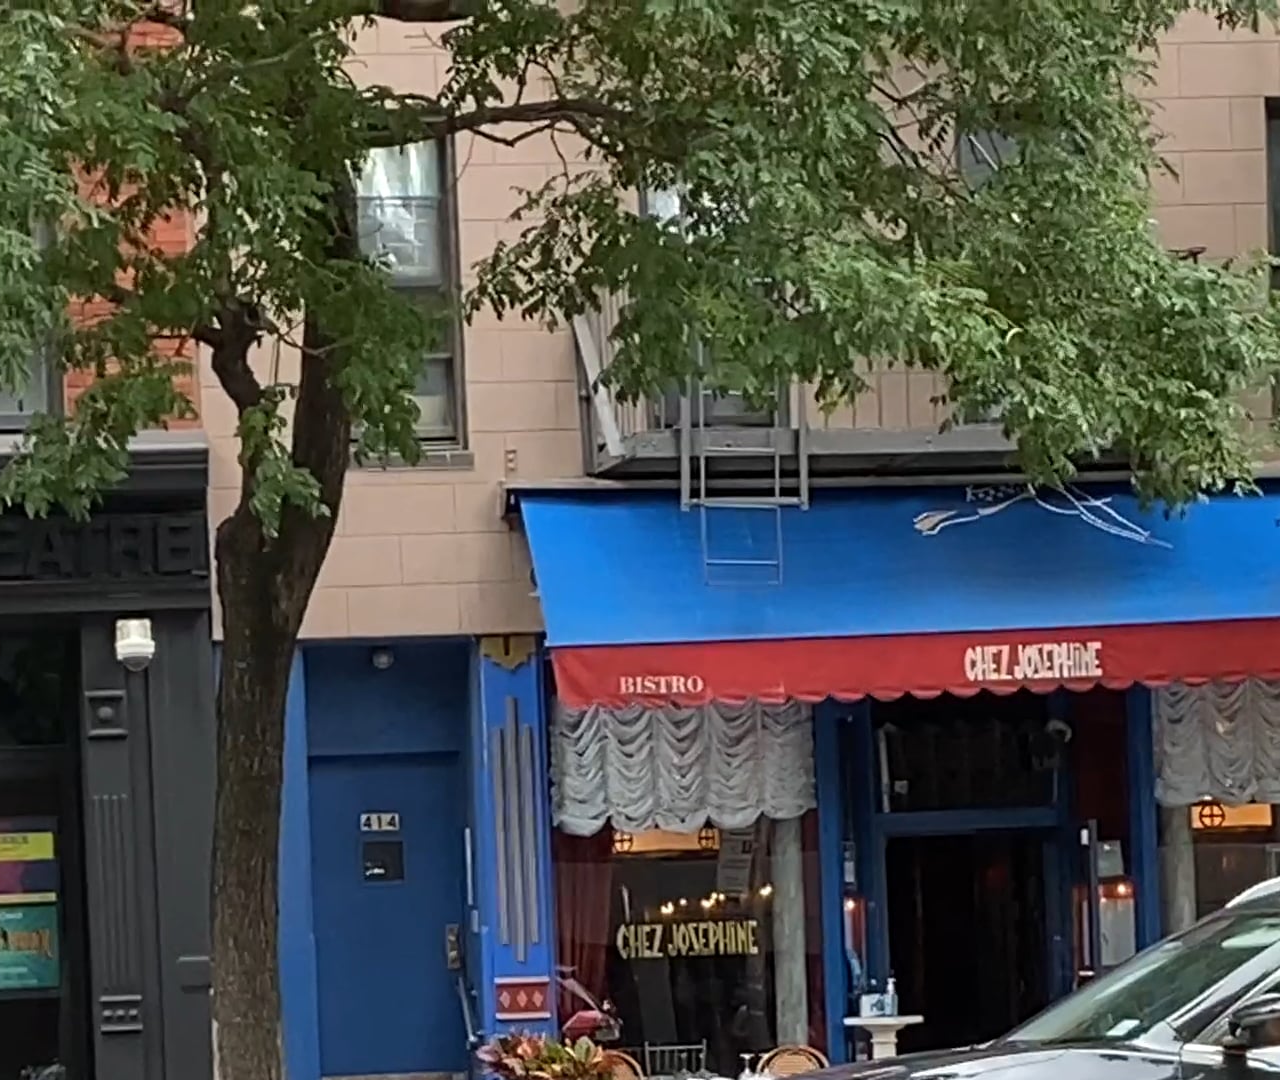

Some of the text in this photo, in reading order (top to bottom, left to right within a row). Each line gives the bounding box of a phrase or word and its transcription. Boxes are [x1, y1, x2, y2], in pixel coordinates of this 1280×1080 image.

[964, 641, 1103, 681] CHEZ JOSEPHINE
[619, 675, 704, 694] BISTRO
[362, 815, 398, 829] 414
[616, 920, 759, 959] CHEZ JOSEPHINE
